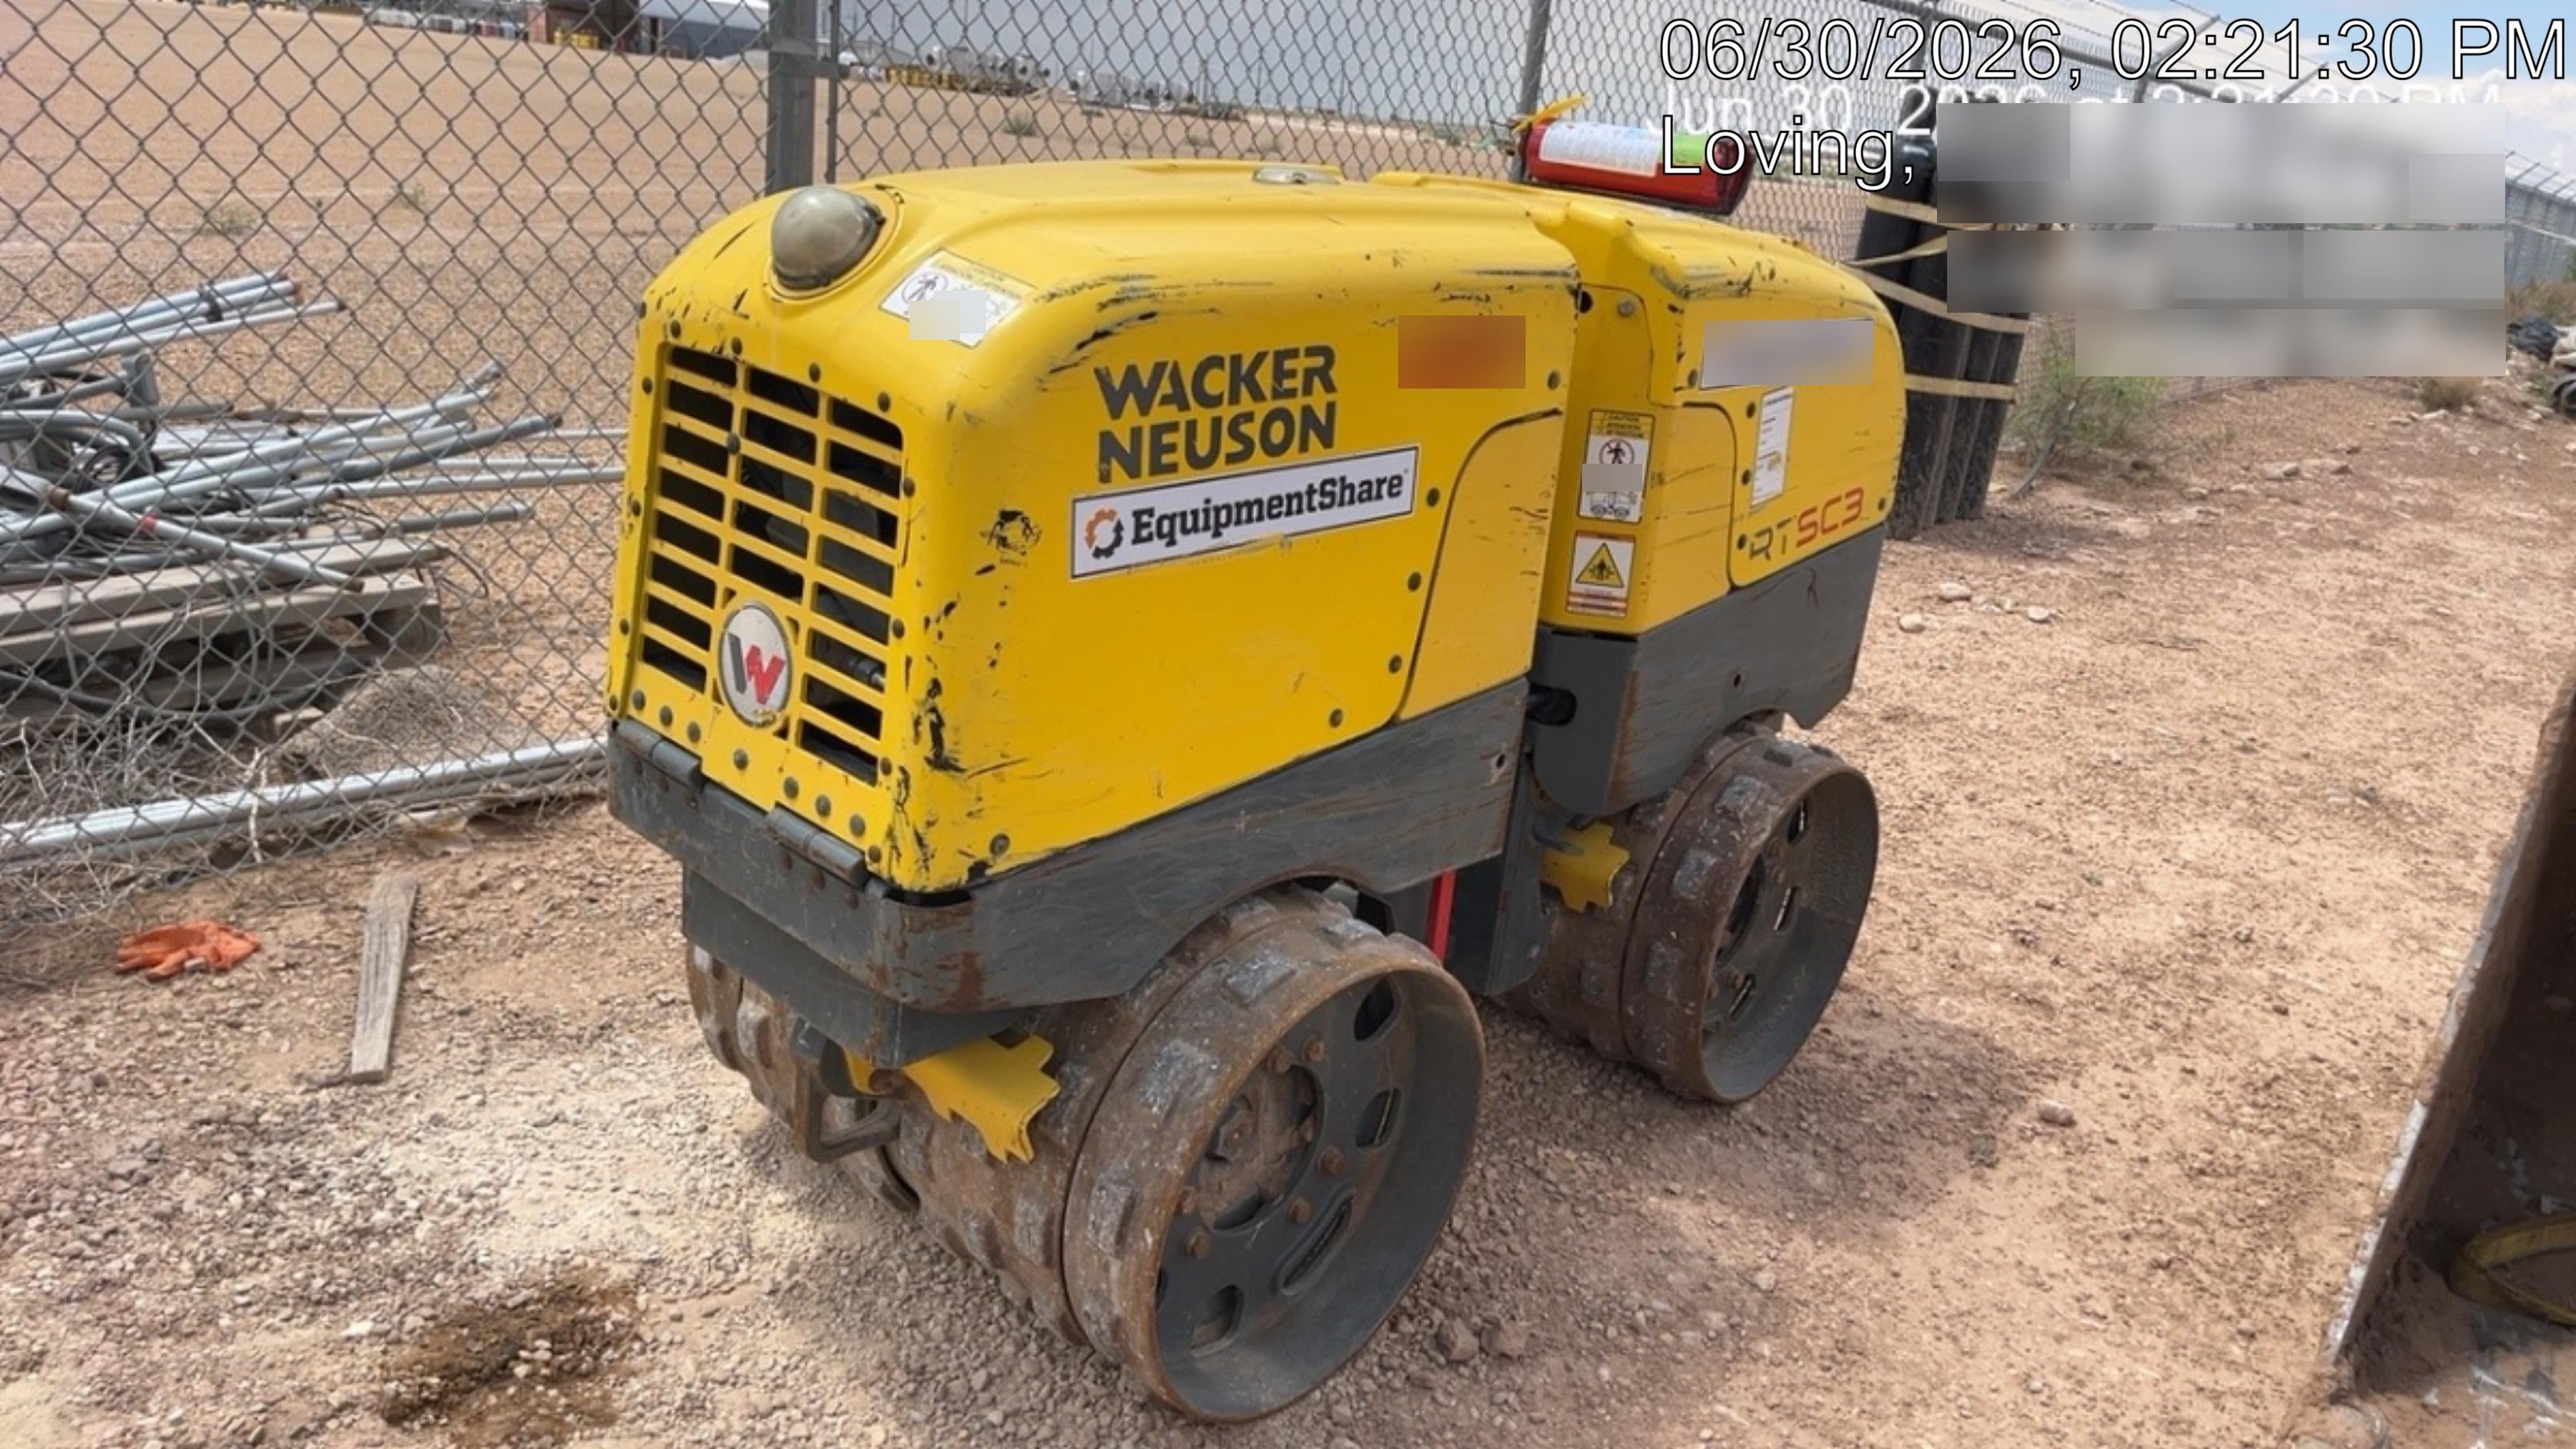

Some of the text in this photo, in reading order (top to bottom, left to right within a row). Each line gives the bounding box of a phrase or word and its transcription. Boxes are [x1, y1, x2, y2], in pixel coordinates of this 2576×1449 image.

[1093, 344, 1337, 421] WACKER
[1098, 401, 1337, 484] NEUSON
[1131, 472, 1405, 547] EquipmentShare
